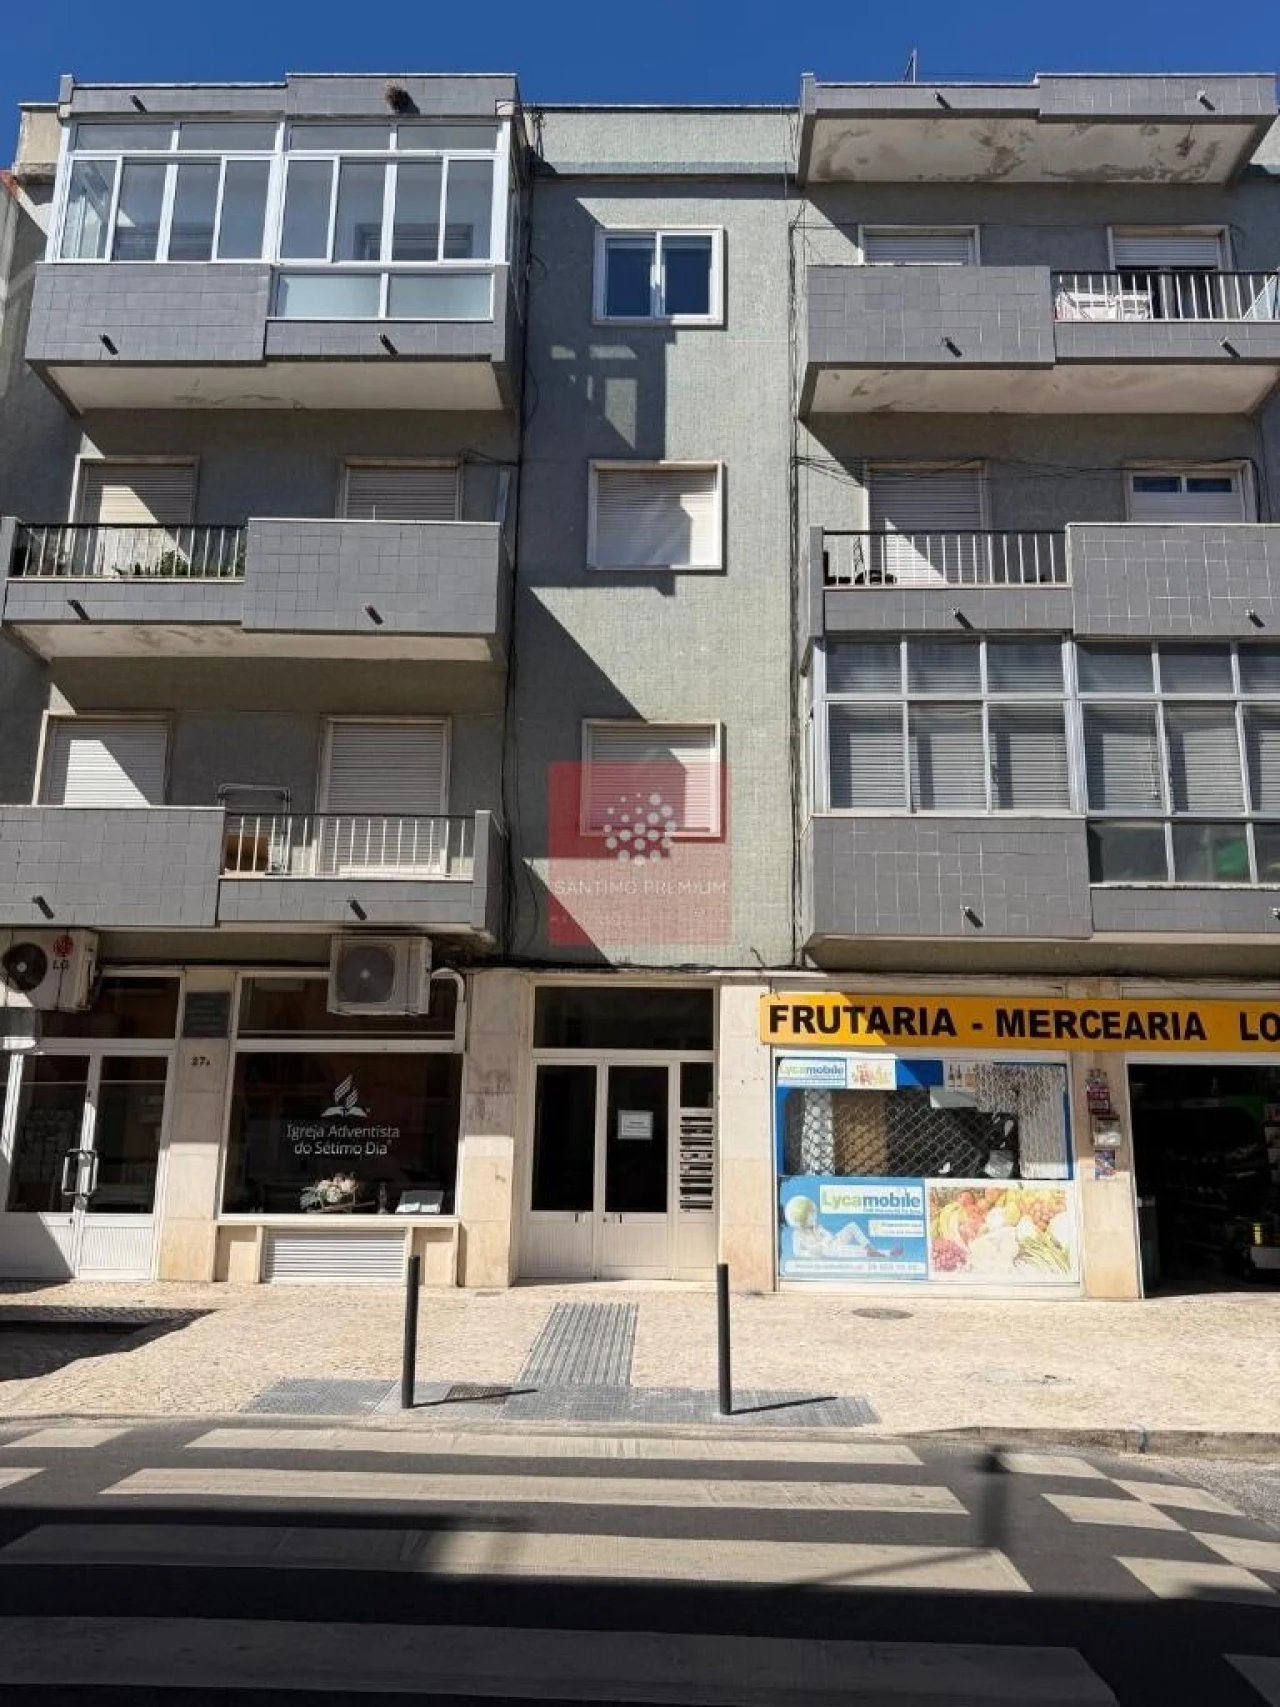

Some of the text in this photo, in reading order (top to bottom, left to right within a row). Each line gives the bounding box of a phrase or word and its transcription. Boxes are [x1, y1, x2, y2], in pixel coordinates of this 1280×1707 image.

[769, 1004, 957, 1036] FRUTARIA
[995, 1008, 1207, 1041] MERCEARIA
[1240, 1012, 1280, 1041] LO
[286, 1124, 400, 1141] Igreja Adventista
[294, 1141, 312, 1155] do
[823, 1189, 921, 1210] Lycamobile
